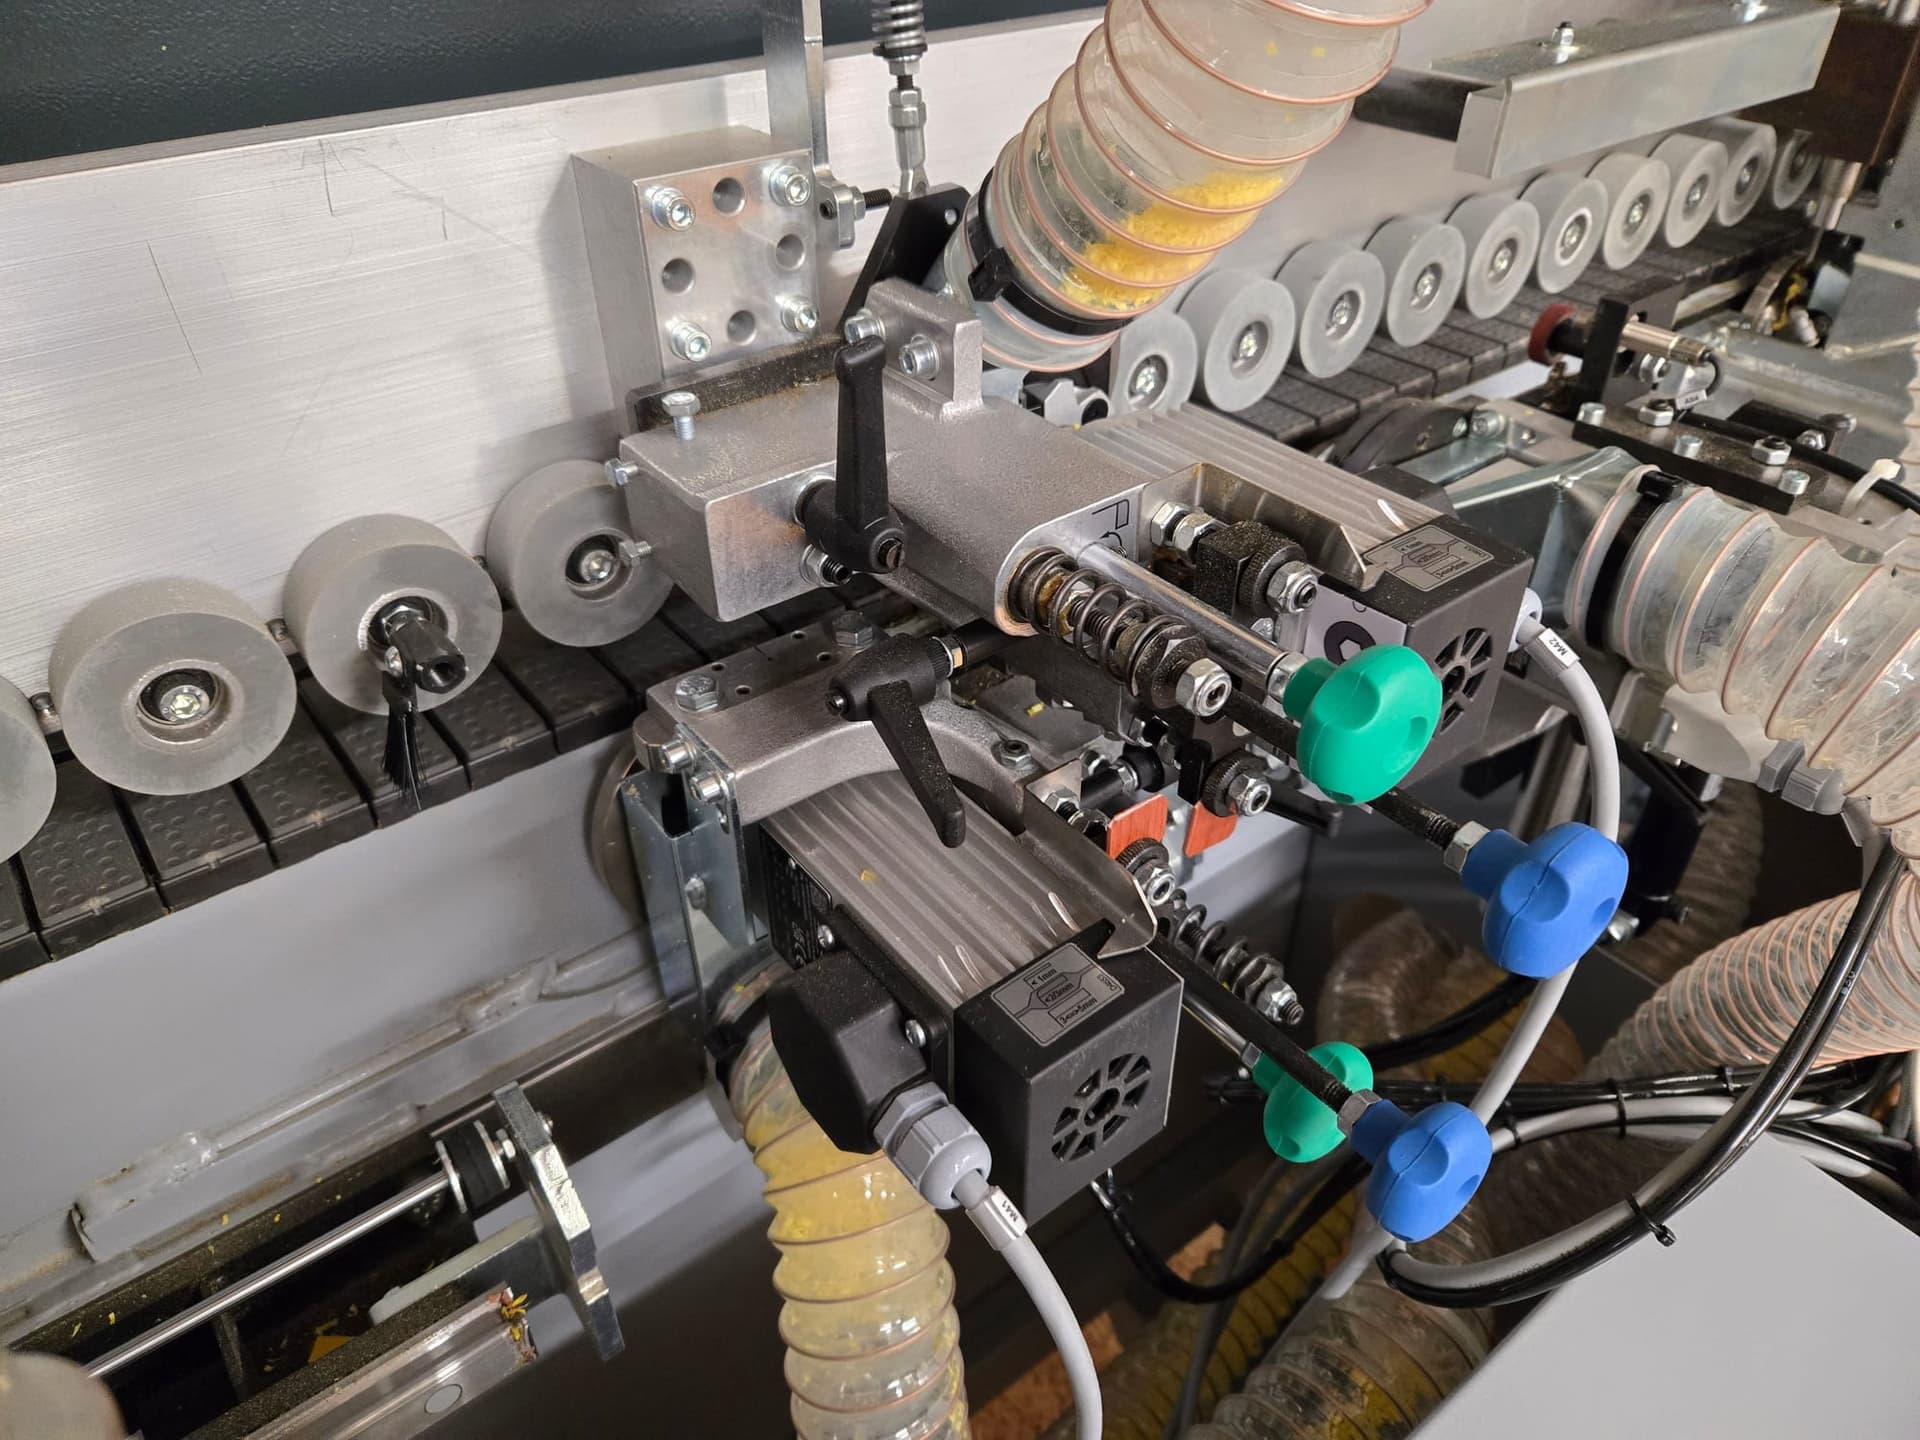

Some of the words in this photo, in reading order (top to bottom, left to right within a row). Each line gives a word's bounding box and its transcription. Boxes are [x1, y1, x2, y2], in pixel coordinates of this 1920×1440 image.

[1548, 636, 1568, 656] M42
[1038, 968, 1057, 983] 1mm
[1002, 1200, 1018, 1222] M41
